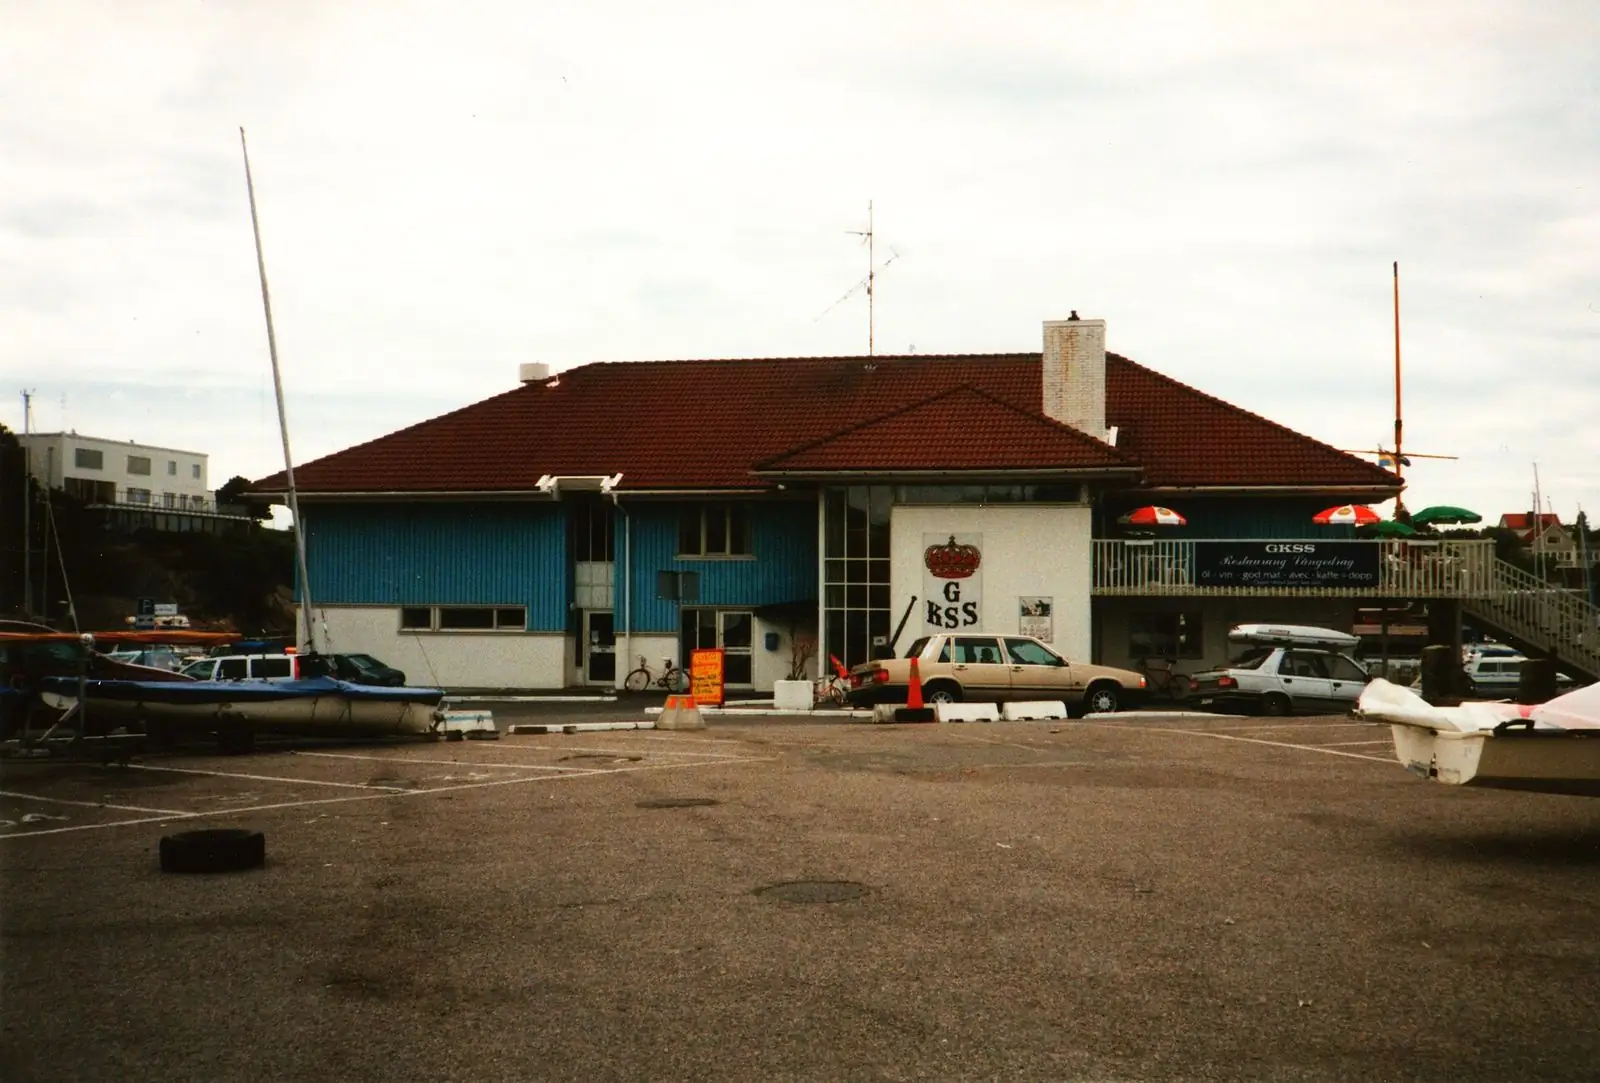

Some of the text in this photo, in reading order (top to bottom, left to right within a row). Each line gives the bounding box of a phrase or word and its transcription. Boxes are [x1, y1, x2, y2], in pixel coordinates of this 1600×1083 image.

[1265, 543, 1316, 554] GKSS
[943, 581, 960, 603] G
[927, 599, 978, 630] KSS
